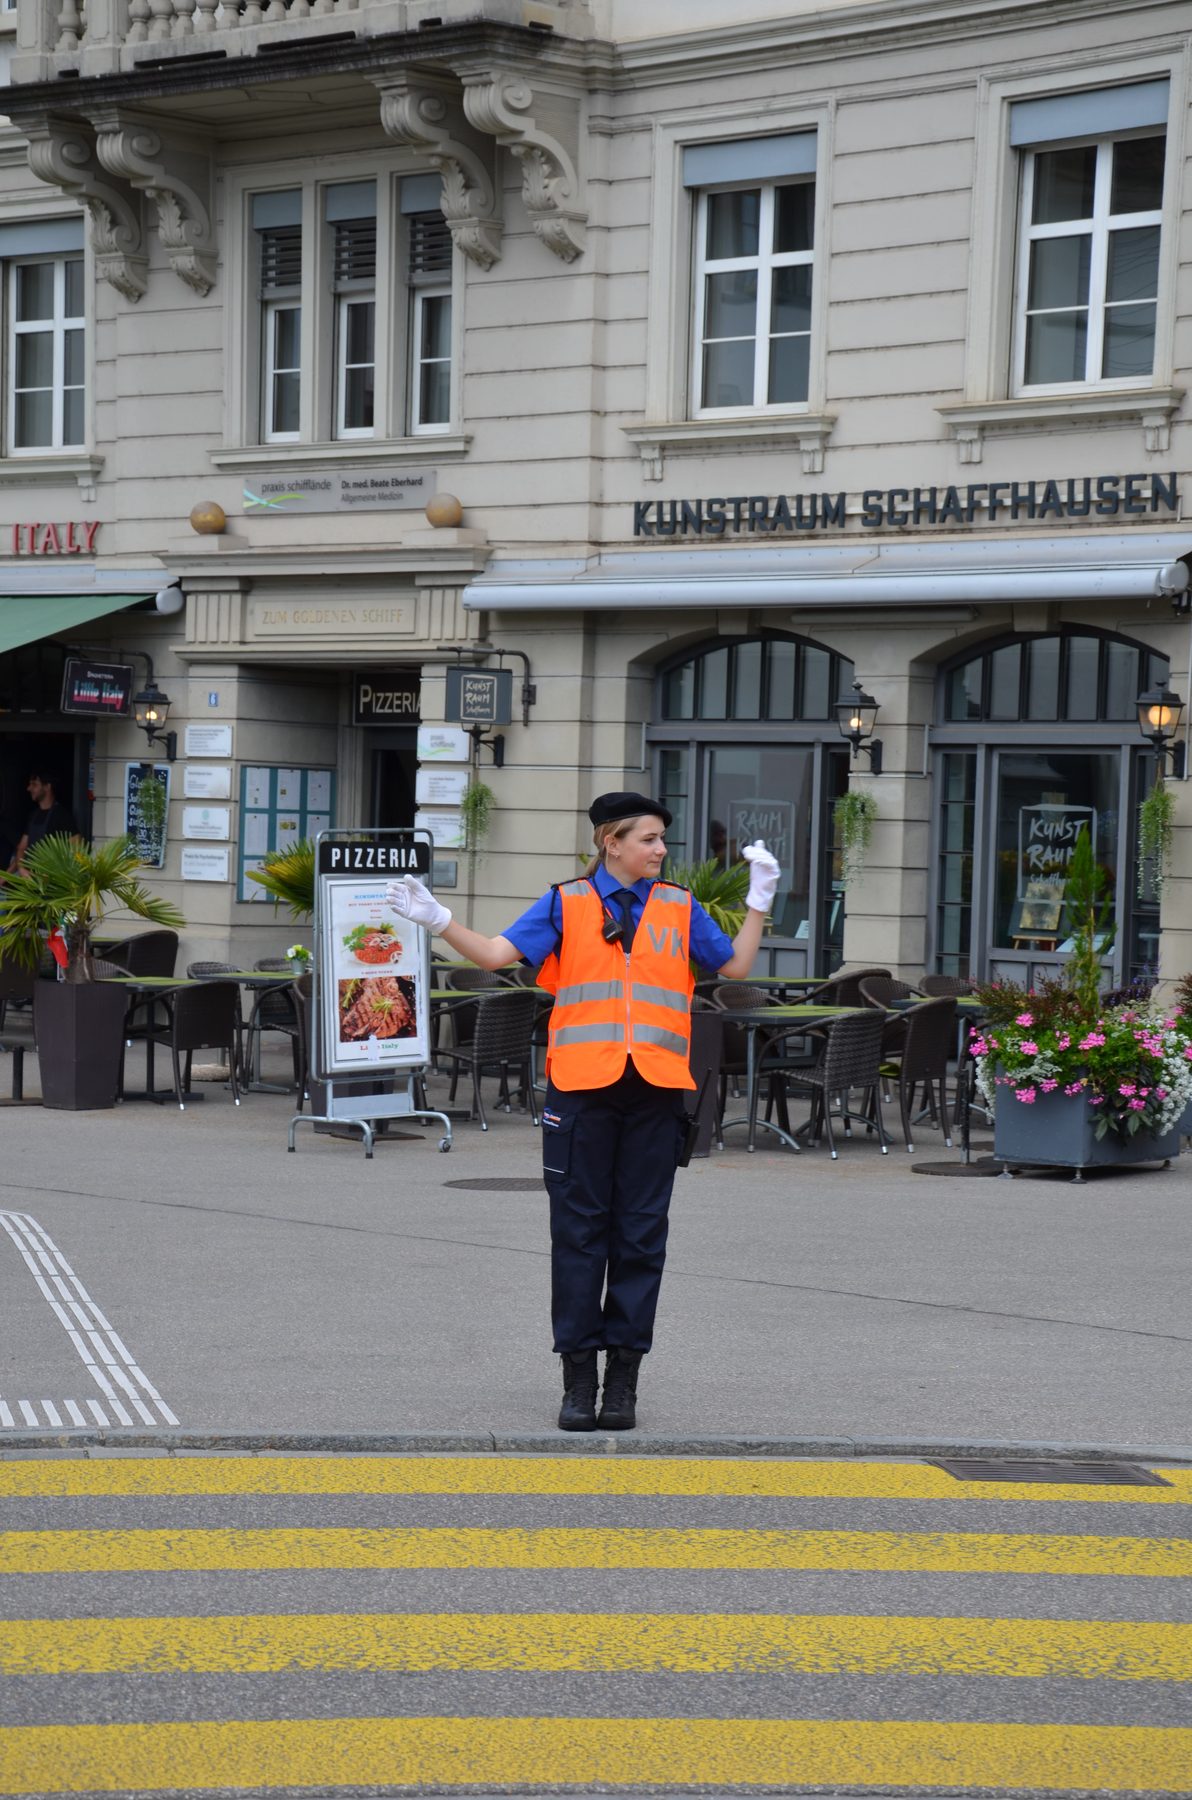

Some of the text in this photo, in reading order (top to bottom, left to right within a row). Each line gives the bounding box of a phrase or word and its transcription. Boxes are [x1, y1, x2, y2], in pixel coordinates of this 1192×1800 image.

[261, 479, 332, 495] praxis schifflände
[341, 476, 423, 489] Dr. med. Beate Eberhard
[341, 491, 404, 504] Allgemeine Medizin
[633, 472, 1177, 536] KUNSTRAUM SCHAFFHAUSEN
[12, 521, 101, 553] ITALY
[262, 608, 404, 625] ZUM GOLDENEN SCHIFF
[465, 680, 493, 692] KUNST
[464, 692, 490, 705] RAUM
[737, 810, 782, 836] RAUM
[1028, 815, 1088, 842] KUNST
[331, 847, 418, 868] PIZZERIA
[646, 922, 687, 962] VK
